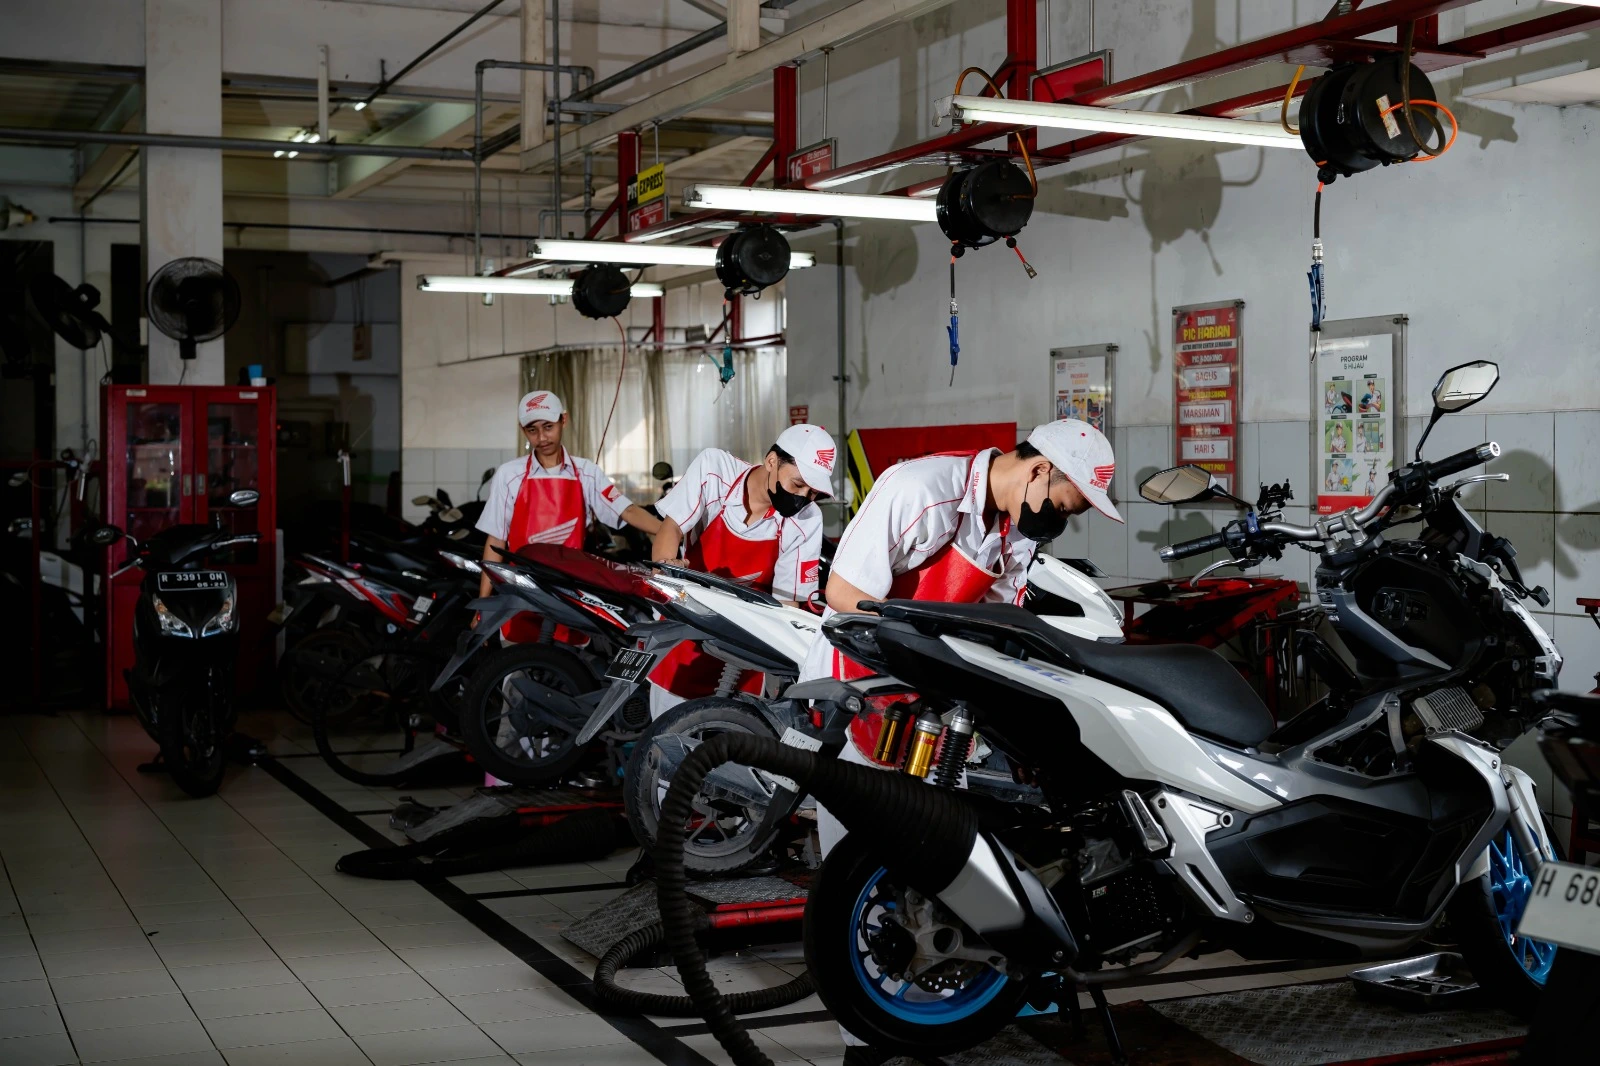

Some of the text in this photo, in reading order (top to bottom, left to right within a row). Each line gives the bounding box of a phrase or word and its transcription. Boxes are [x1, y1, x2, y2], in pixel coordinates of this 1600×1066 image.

[790, 159, 802, 181] 16
[639, 170, 664, 196] EXPRESS
[631, 212, 640, 231] 15
[1183, 325, 1231, 341] PIC HARIAN
[1340, 354, 1368, 363] PROGRAM
[1347, 362, 1365, 370] HIJAU
[1195, 370, 1218, 382] BAGUS
[1183, 407, 1221, 418] MARSIMAN
[1194, 444, 1216, 454] HARI S
[161, 574, 168, 582] R
[176, 573, 201, 581] 3391
[1536, 868, 1557, 898] H
